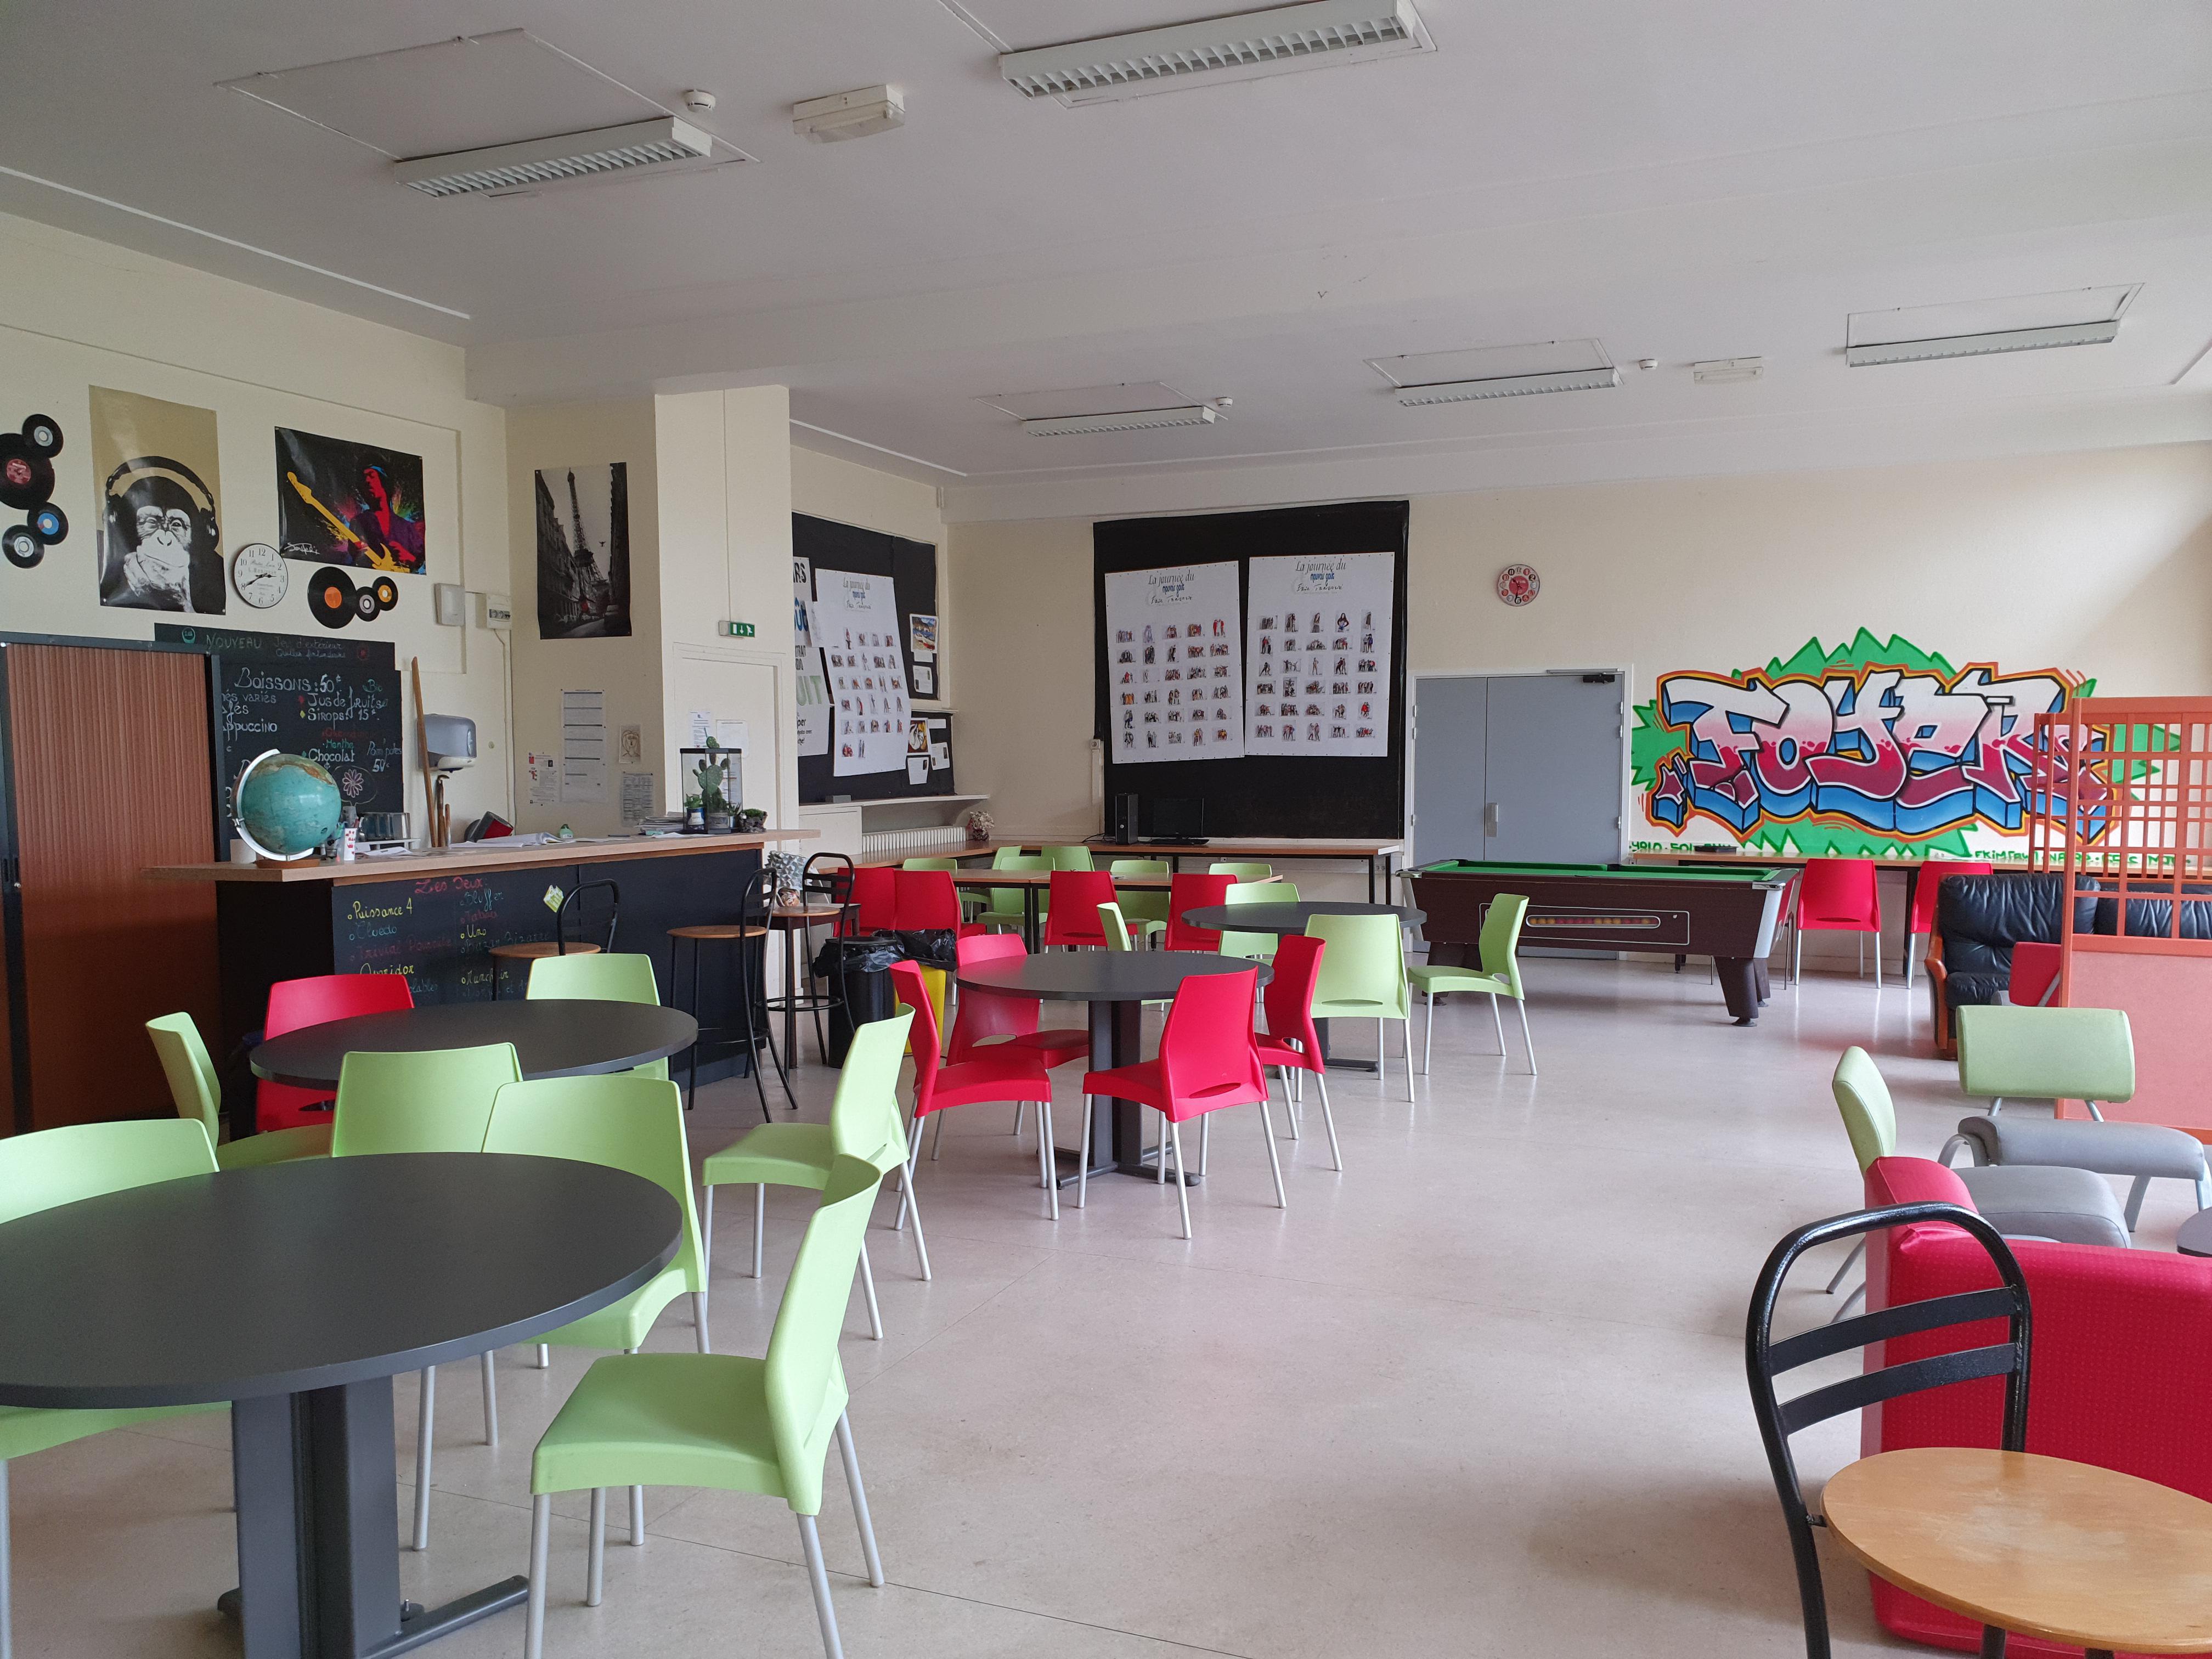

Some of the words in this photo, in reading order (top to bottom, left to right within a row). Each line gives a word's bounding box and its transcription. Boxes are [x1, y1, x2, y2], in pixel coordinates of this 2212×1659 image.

[1295, 561, 1305, 571] La
[1336, 558, 1346, 571] du
[1186, 569, 1194, 581] du
[206, 633, 262, 650] NOUVEAU
[307, 692, 332, 707] Jus
[333, 691, 346, 707] de
[308, 748, 356, 762] Chocolat
[1656, 670, 2112, 842] FOYER
[414, 879, 448, 894] Les
[353, 901, 403, 920] Puissance
[406, 897, 413, 915] 4
[467, 924, 487, 938] Uno
